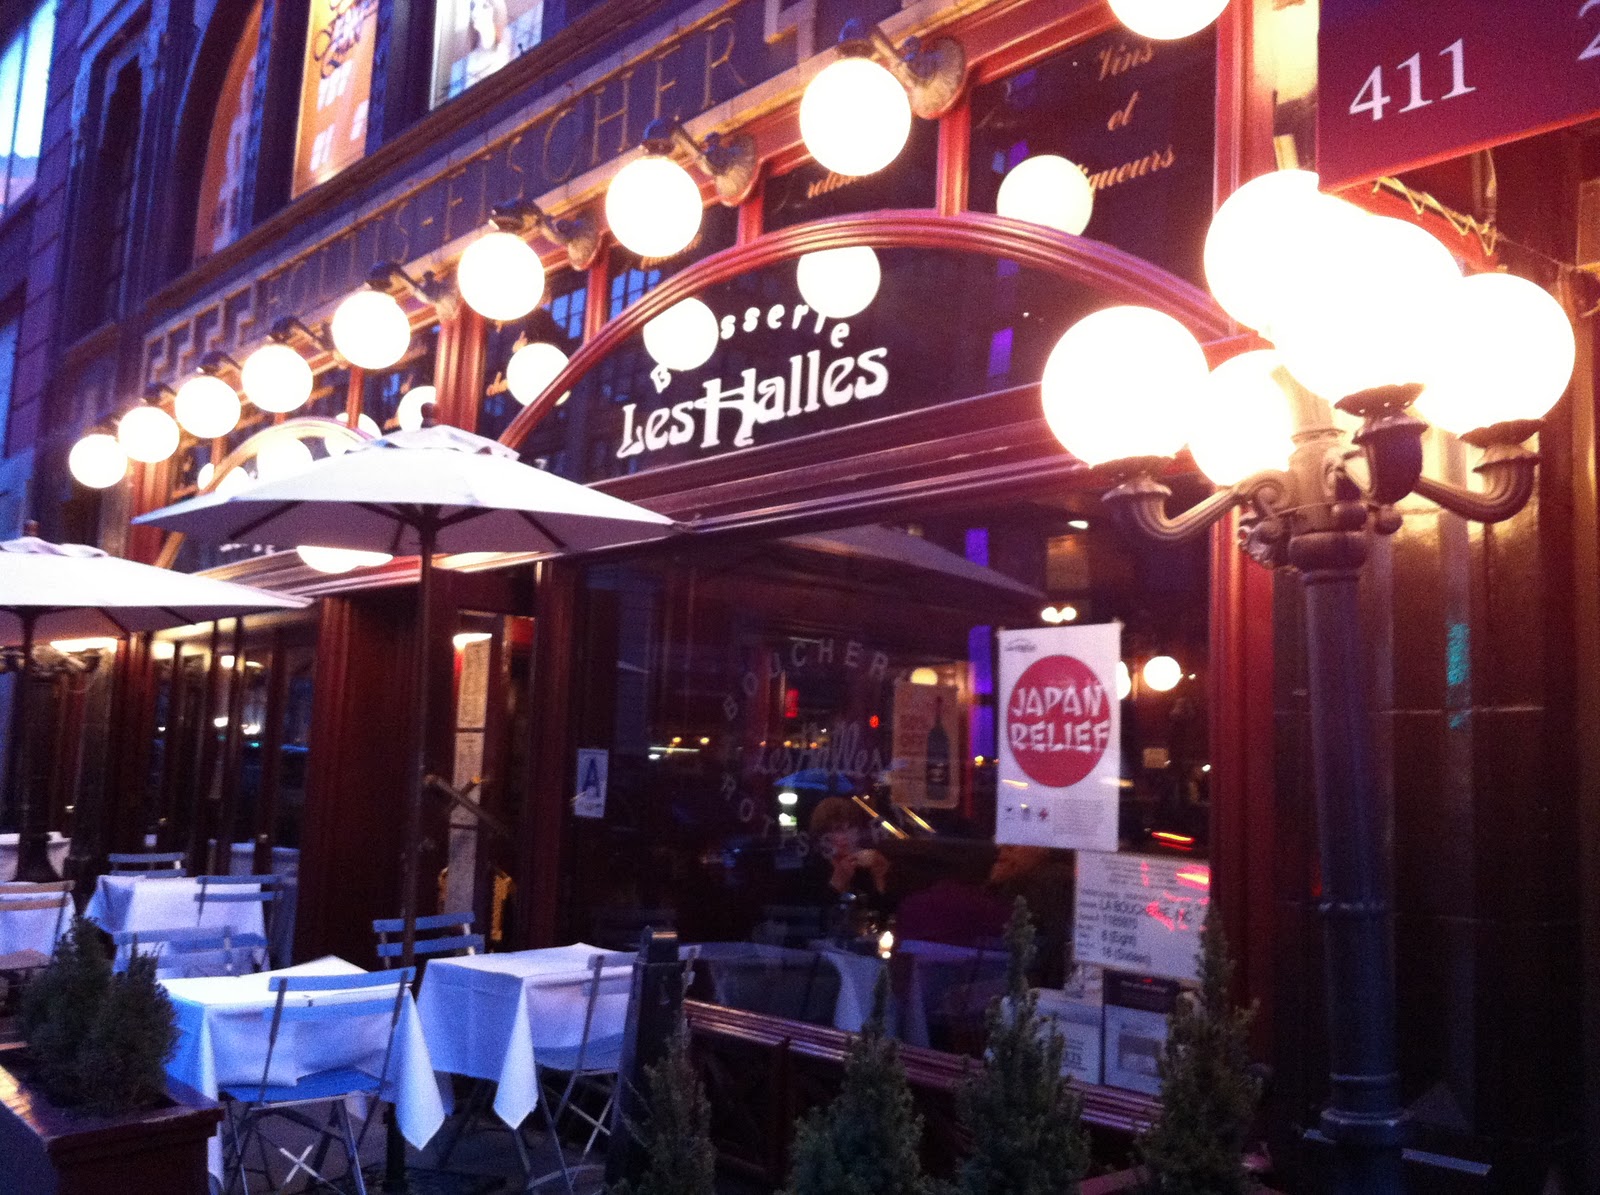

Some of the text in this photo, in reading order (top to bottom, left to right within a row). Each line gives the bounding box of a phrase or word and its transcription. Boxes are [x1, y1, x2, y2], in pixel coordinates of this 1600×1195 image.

[1349, 38, 1477, 121] 411
[1078, 144, 1175, 190] queurs
[650, 303, 850, 394] Bsserie
[616, 347, 889, 458] Les Halles
[1011, 683, 1104, 718] JAPAN
[1010, 719, 1110, 753] RELIEF
[582, 758, 600, 797] A
